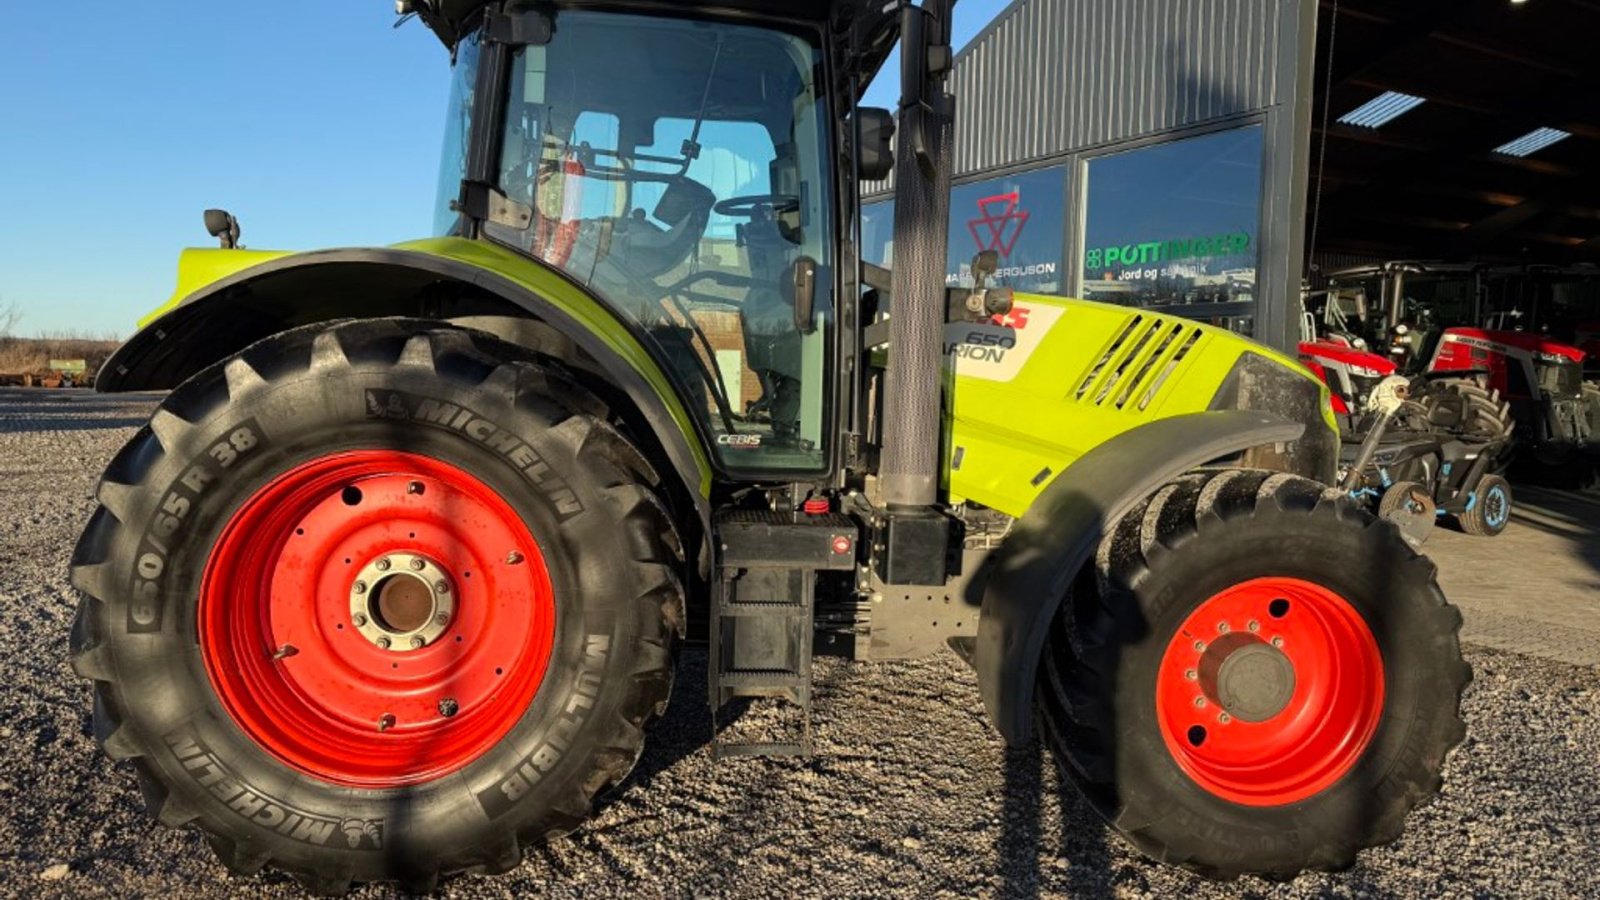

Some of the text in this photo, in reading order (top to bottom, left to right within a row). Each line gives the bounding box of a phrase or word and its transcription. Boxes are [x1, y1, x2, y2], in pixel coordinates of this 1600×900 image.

[1118, 267, 1142, 281] Jord
[1143, 267, 1158, 280] og
[942, 341, 1006, 364] RION
[965, 330, 1016, 350] 650
[414, 399, 583, 515] MICHELIN
[717, 433, 762, 446] CEBIS
[131, 426, 259, 625] 650/65 R 38
[500, 633, 611, 801] MULTIBIB
[164, 733, 340, 846] MICHELIN
